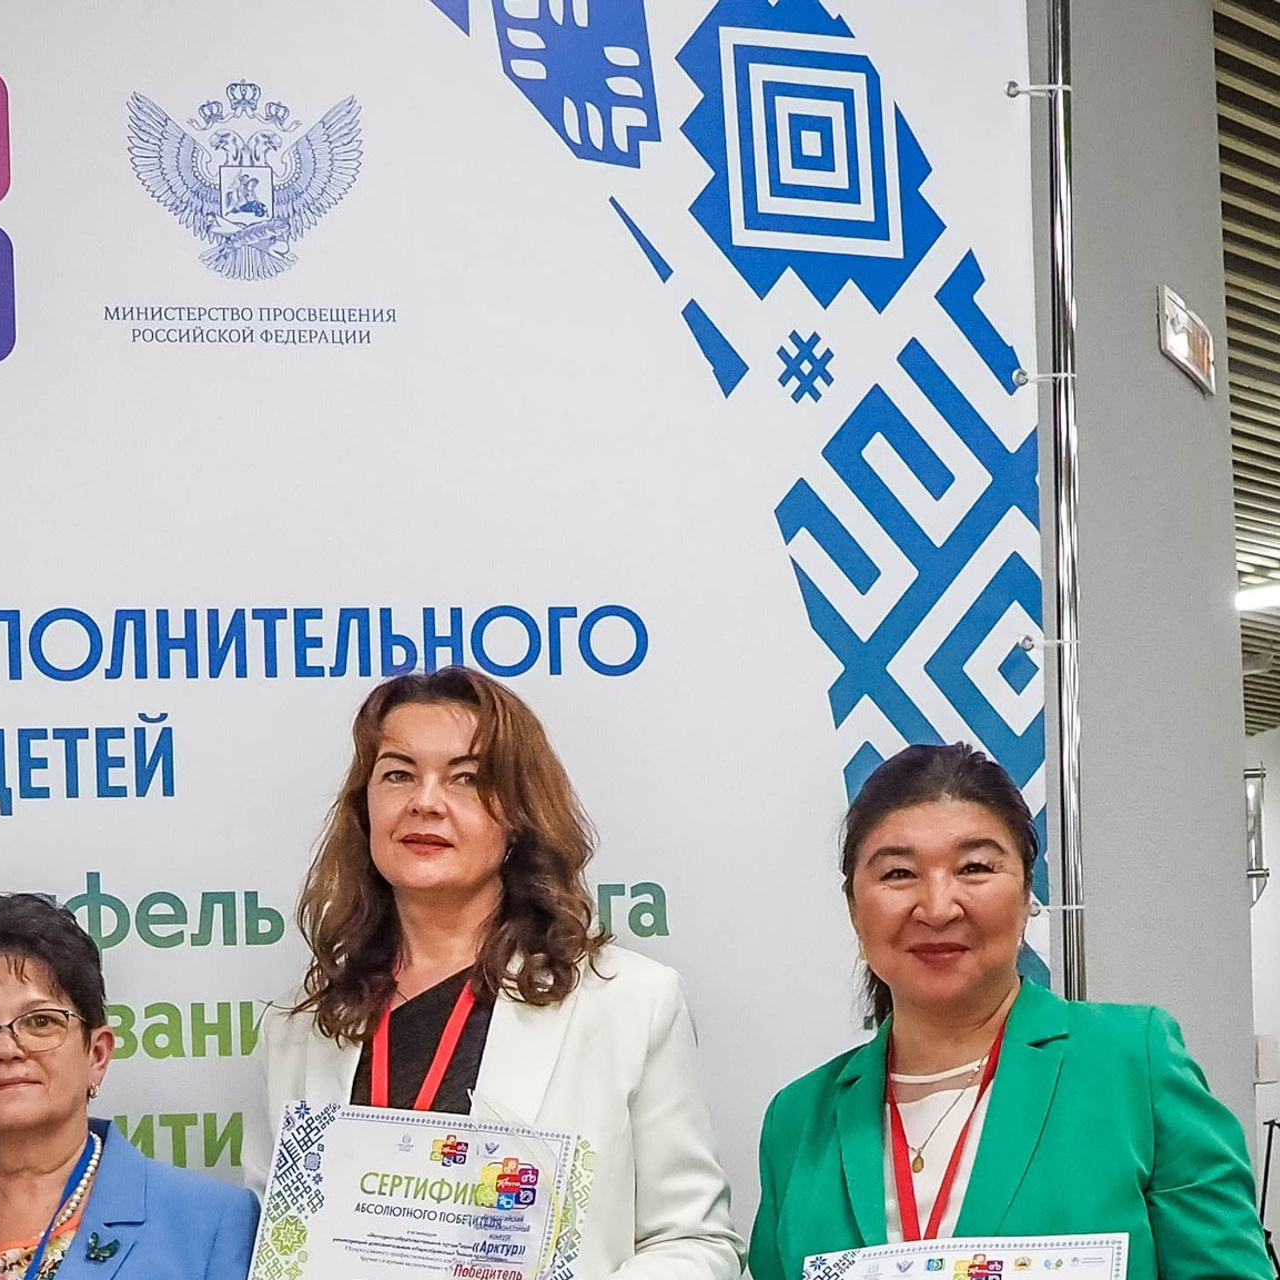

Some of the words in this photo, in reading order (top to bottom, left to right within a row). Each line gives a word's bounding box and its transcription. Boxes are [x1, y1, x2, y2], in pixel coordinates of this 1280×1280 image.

[103, 305, 253, 322] МИНИСТЕРСТВО
[259, 307, 397, 324] ПРОСВЕЩЕНИЯ
[131, 325, 254, 344] РОССИЙСКОЙ
[260, 329, 371, 345] ФЕДЕРАЦИИ
[354, 1202, 437, 1221] АБСОЛЮТНОГО
[472, 1240, 526, 1256] «Арктур»
[453, 1264, 523, 1280] Победитель
